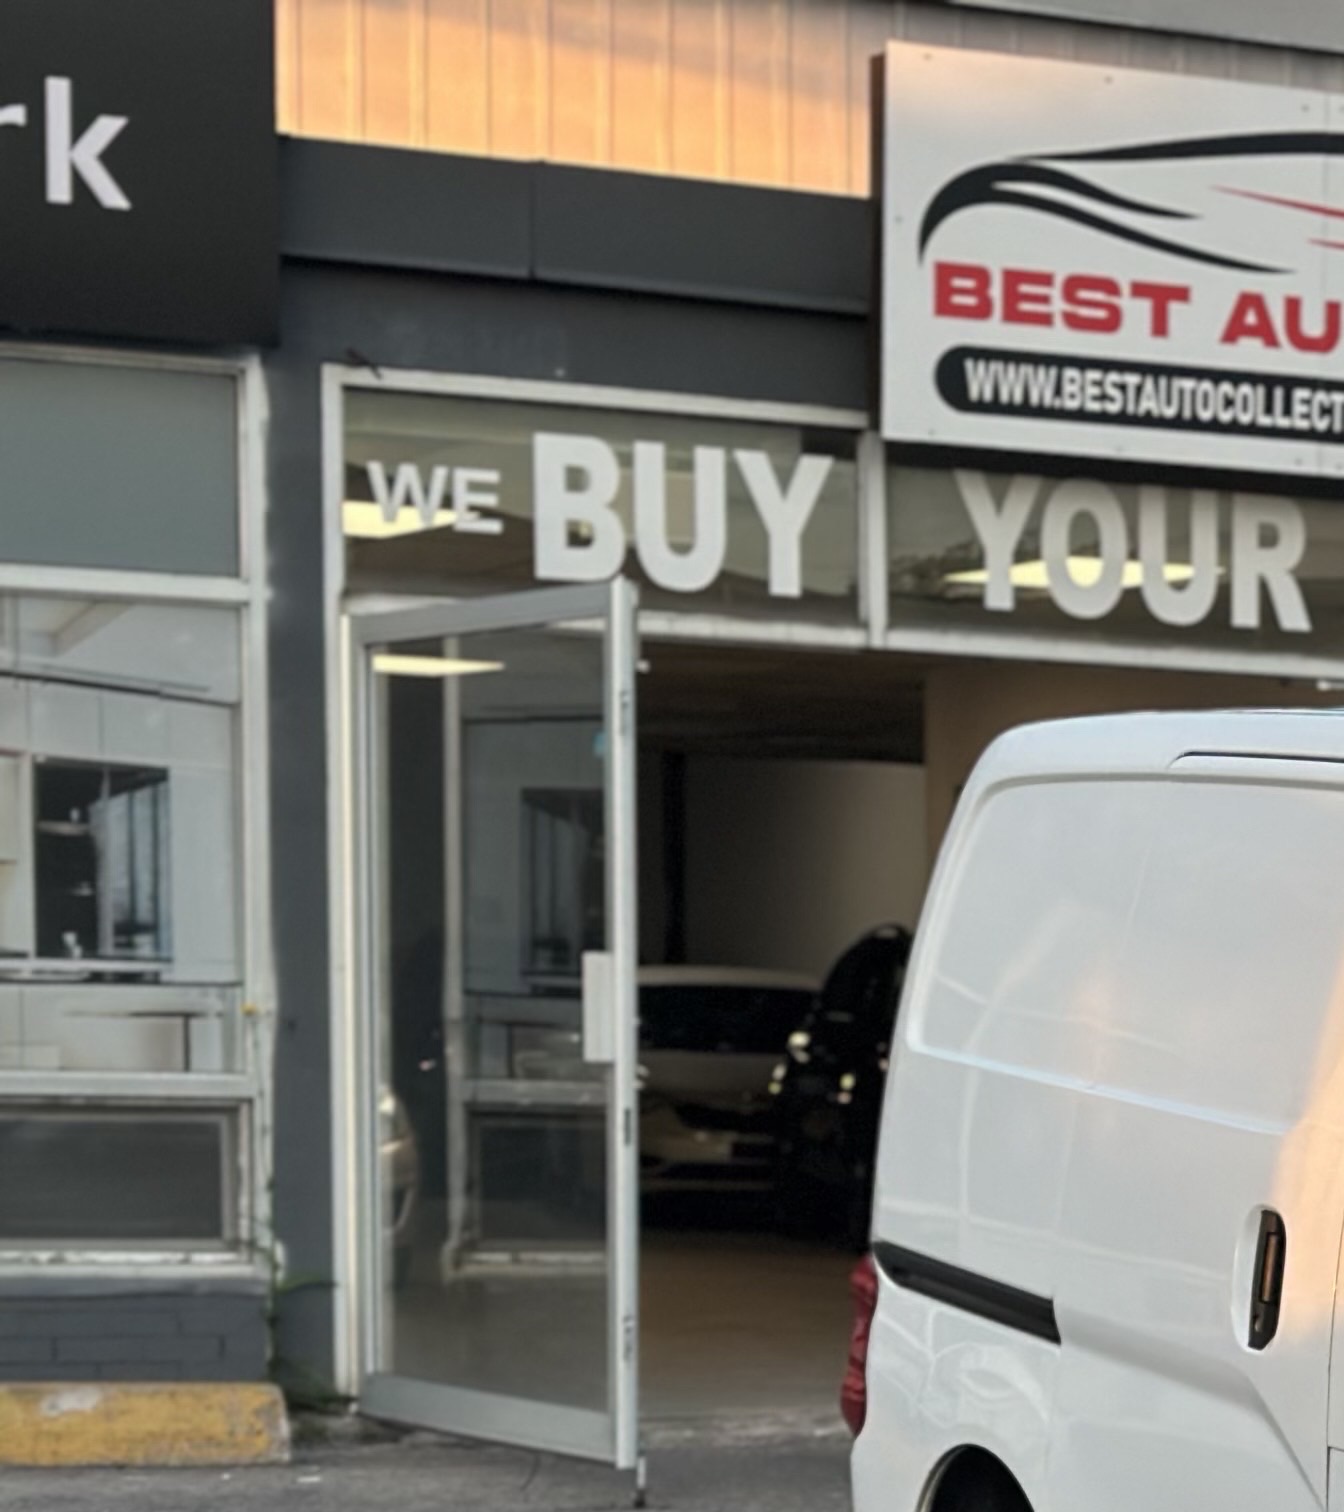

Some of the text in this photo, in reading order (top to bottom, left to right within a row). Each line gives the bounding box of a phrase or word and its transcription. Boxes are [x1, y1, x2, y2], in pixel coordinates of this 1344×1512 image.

[0, 75, 132, 211] k
[934, 261, 1191, 338] BEST
[367, 460, 504, 535] WE
[532, 431, 835, 598] BUY
[954, 470, 1313, 633] YOUR
